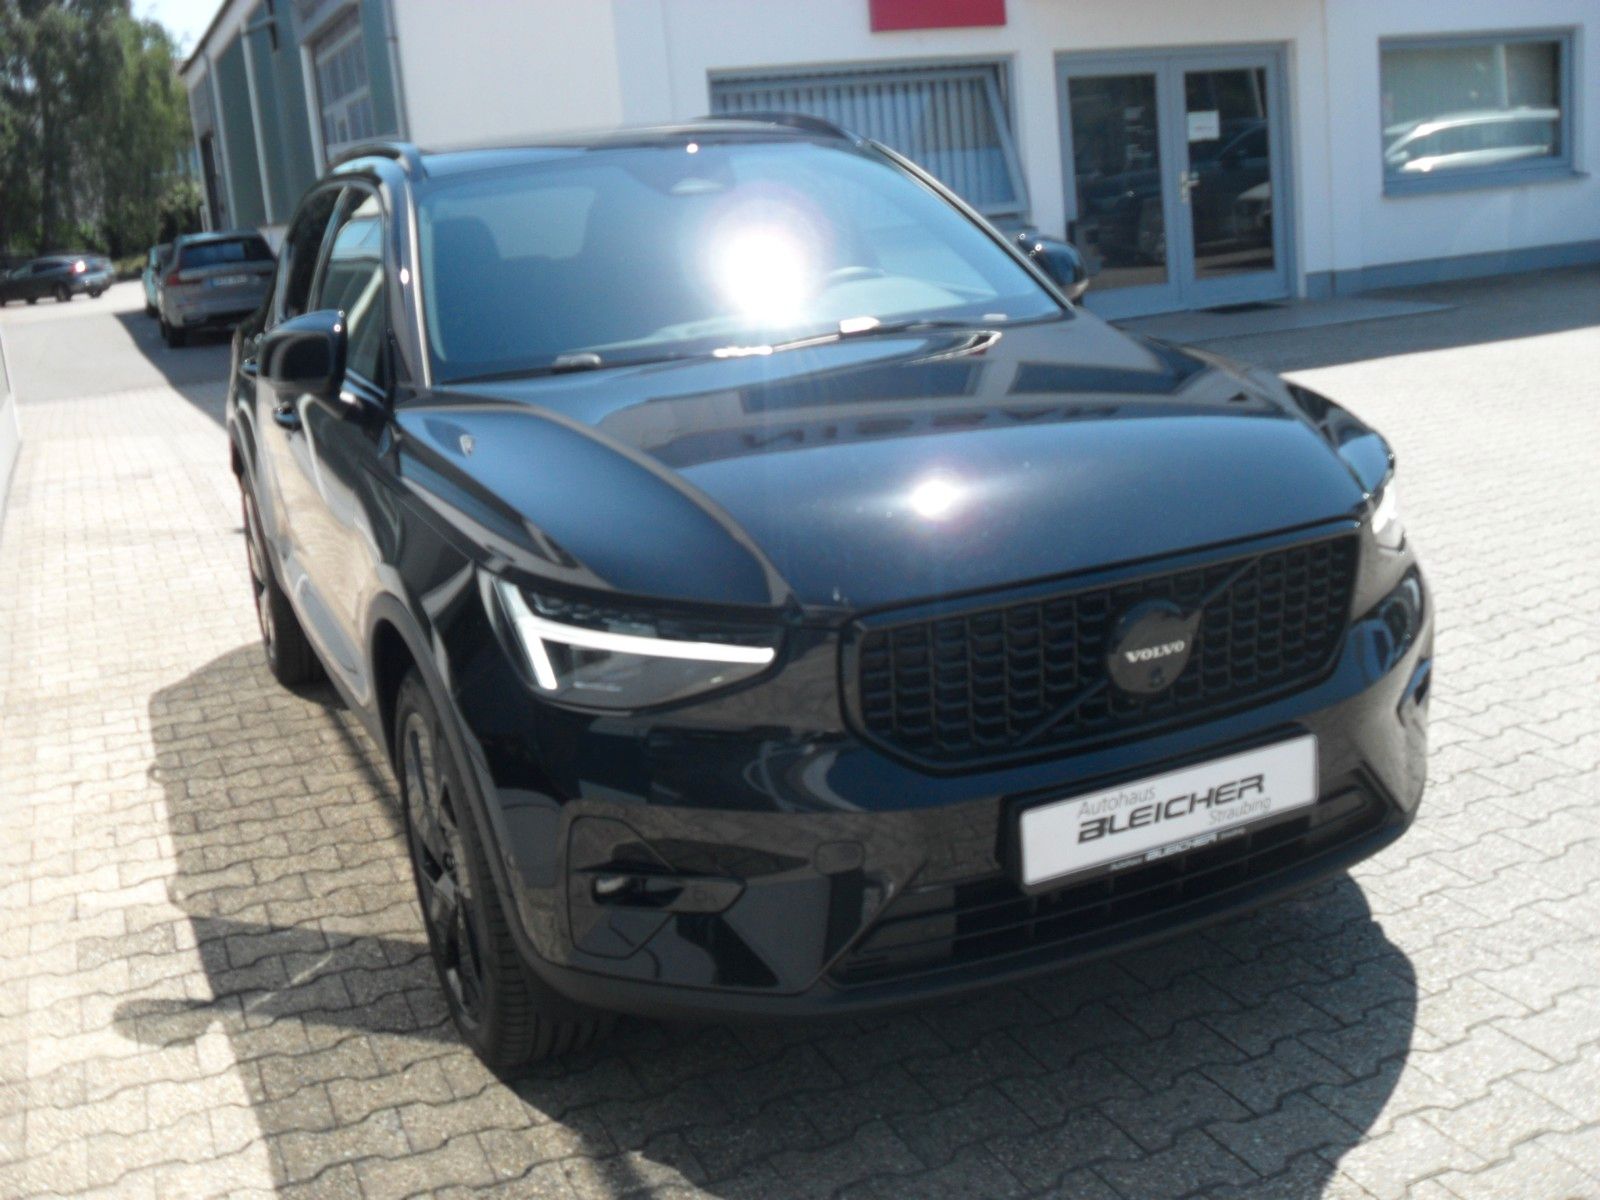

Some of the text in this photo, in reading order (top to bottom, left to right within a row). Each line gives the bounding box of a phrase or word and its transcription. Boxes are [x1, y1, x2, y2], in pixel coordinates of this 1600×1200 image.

[1126, 640, 1185, 663] VOLVO
[1077, 774, 1264, 844] BLEICHER
[1079, 786, 1156, 818] Autohaus
[1209, 797, 1272, 825] Straubing
